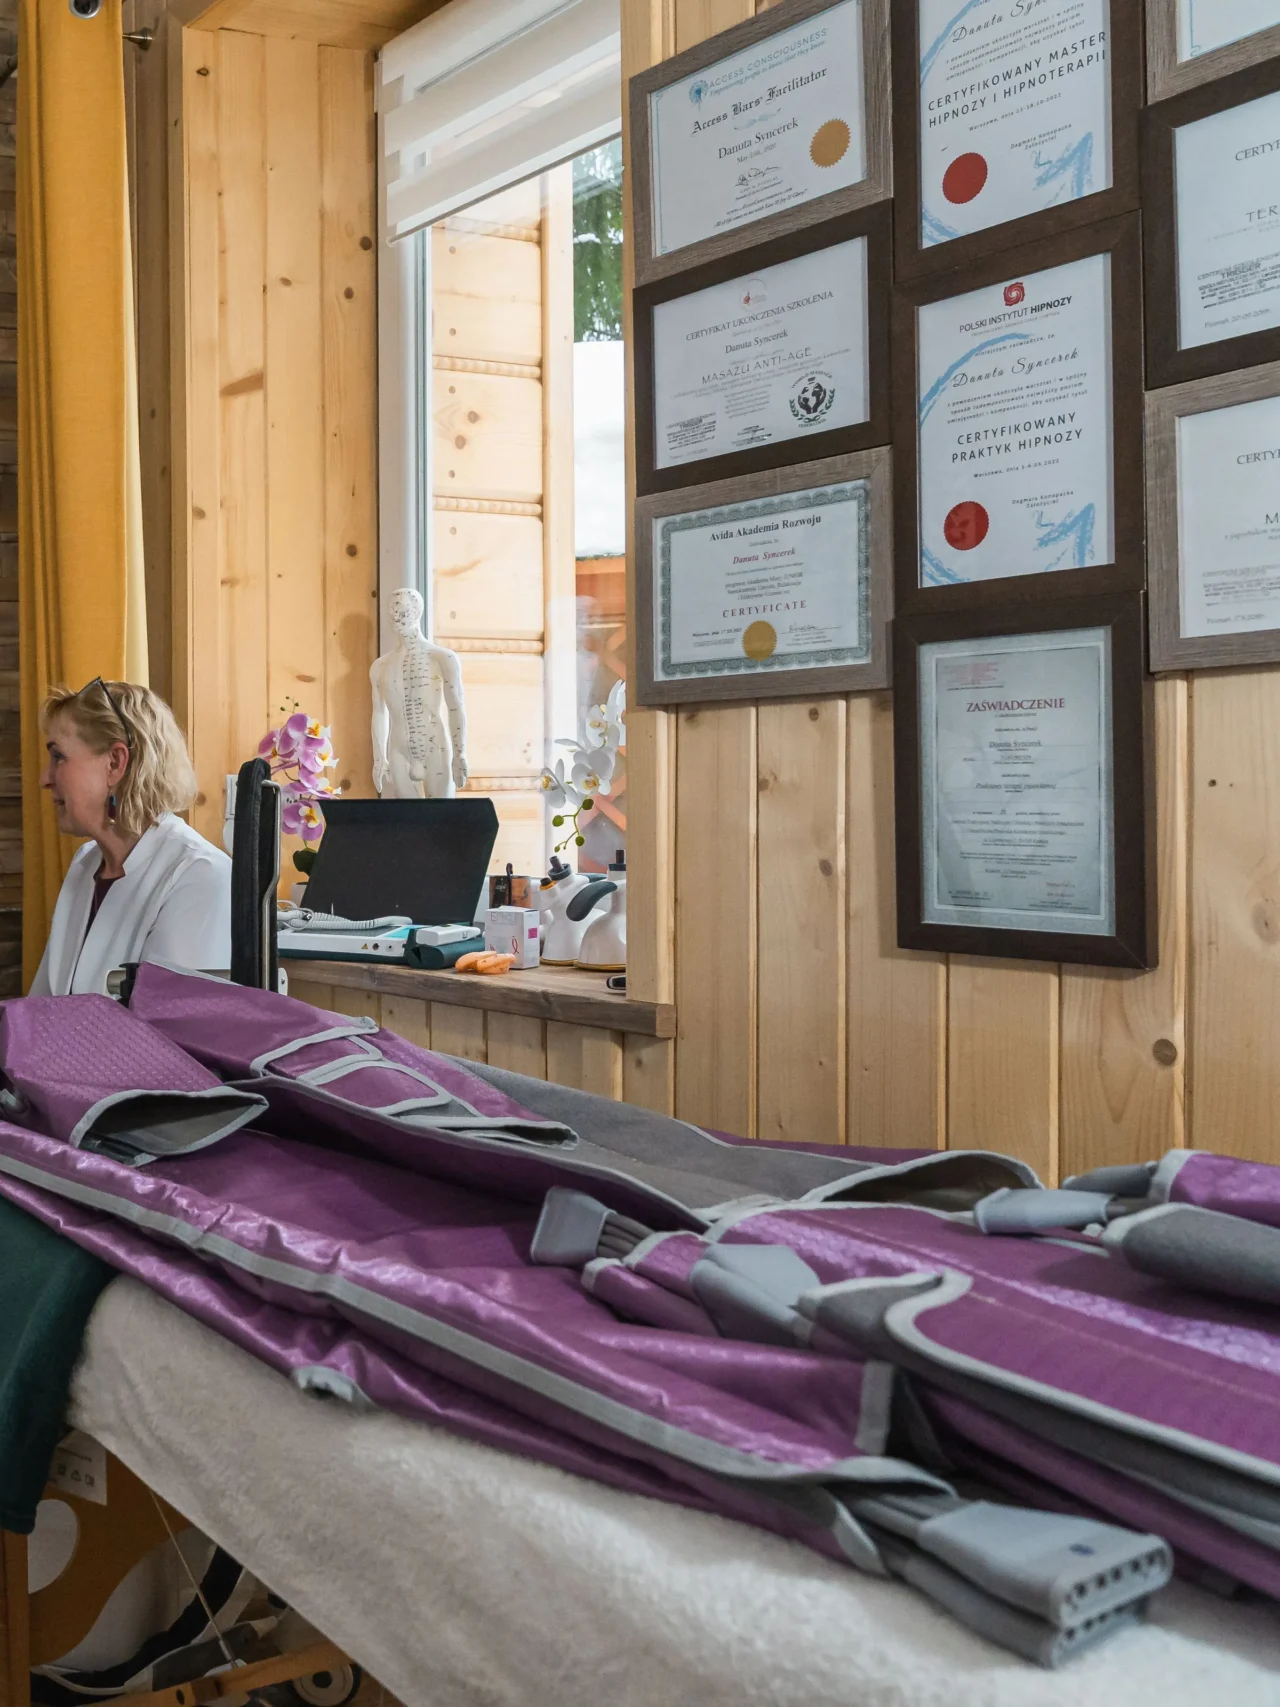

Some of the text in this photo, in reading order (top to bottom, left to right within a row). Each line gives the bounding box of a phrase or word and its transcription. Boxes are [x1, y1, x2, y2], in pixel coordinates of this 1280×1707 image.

[952, 13, 1004, 43] Danuta
[709, 28, 828, 88] ACCESS CONSCIOUSNESS
[928, 31, 1106, 111] CERTYFIKOWANY MASTER
[692, 113, 728, 135] Access
[765, 68, 828, 102] Facilitator
[929, 97, 987, 128] HIPNOZY
[1003, 49, 1106, 99] HIPNOTERAPII
[718, 117, 799, 159] Danuta Syncerek
[685, 321, 731, 342] CERTYFIKAT
[732, 305, 786, 327] UKOŃCZENIA
[787, 290, 834, 311] SZKOLENIA
[960, 318, 987, 334] POLSKI
[988, 308, 1028, 325] INSTYTUT
[1030, 295, 1072, 315] HIPNOZY
[725, 329, 789, 354] Danuta Syncerek
[702, 346, 812, 385] MASAŻU ANTI-AGE
[952, 347, 1079, 388] Danuta Syncerek
[952, 428, 1083, 463] PRAKTYK HIPNOZY
[957, 412, 1076, 445] CERTYFIKOWANY
[710, 515, 822, 542] Avida Akademia Rozwoju
[733, 547, 797, 565] Danuta Syncerek
[722, 600, 807, 618] CERTYFICATE
[966, 698, 1065, 713] ZAŚWIADCZENIE
